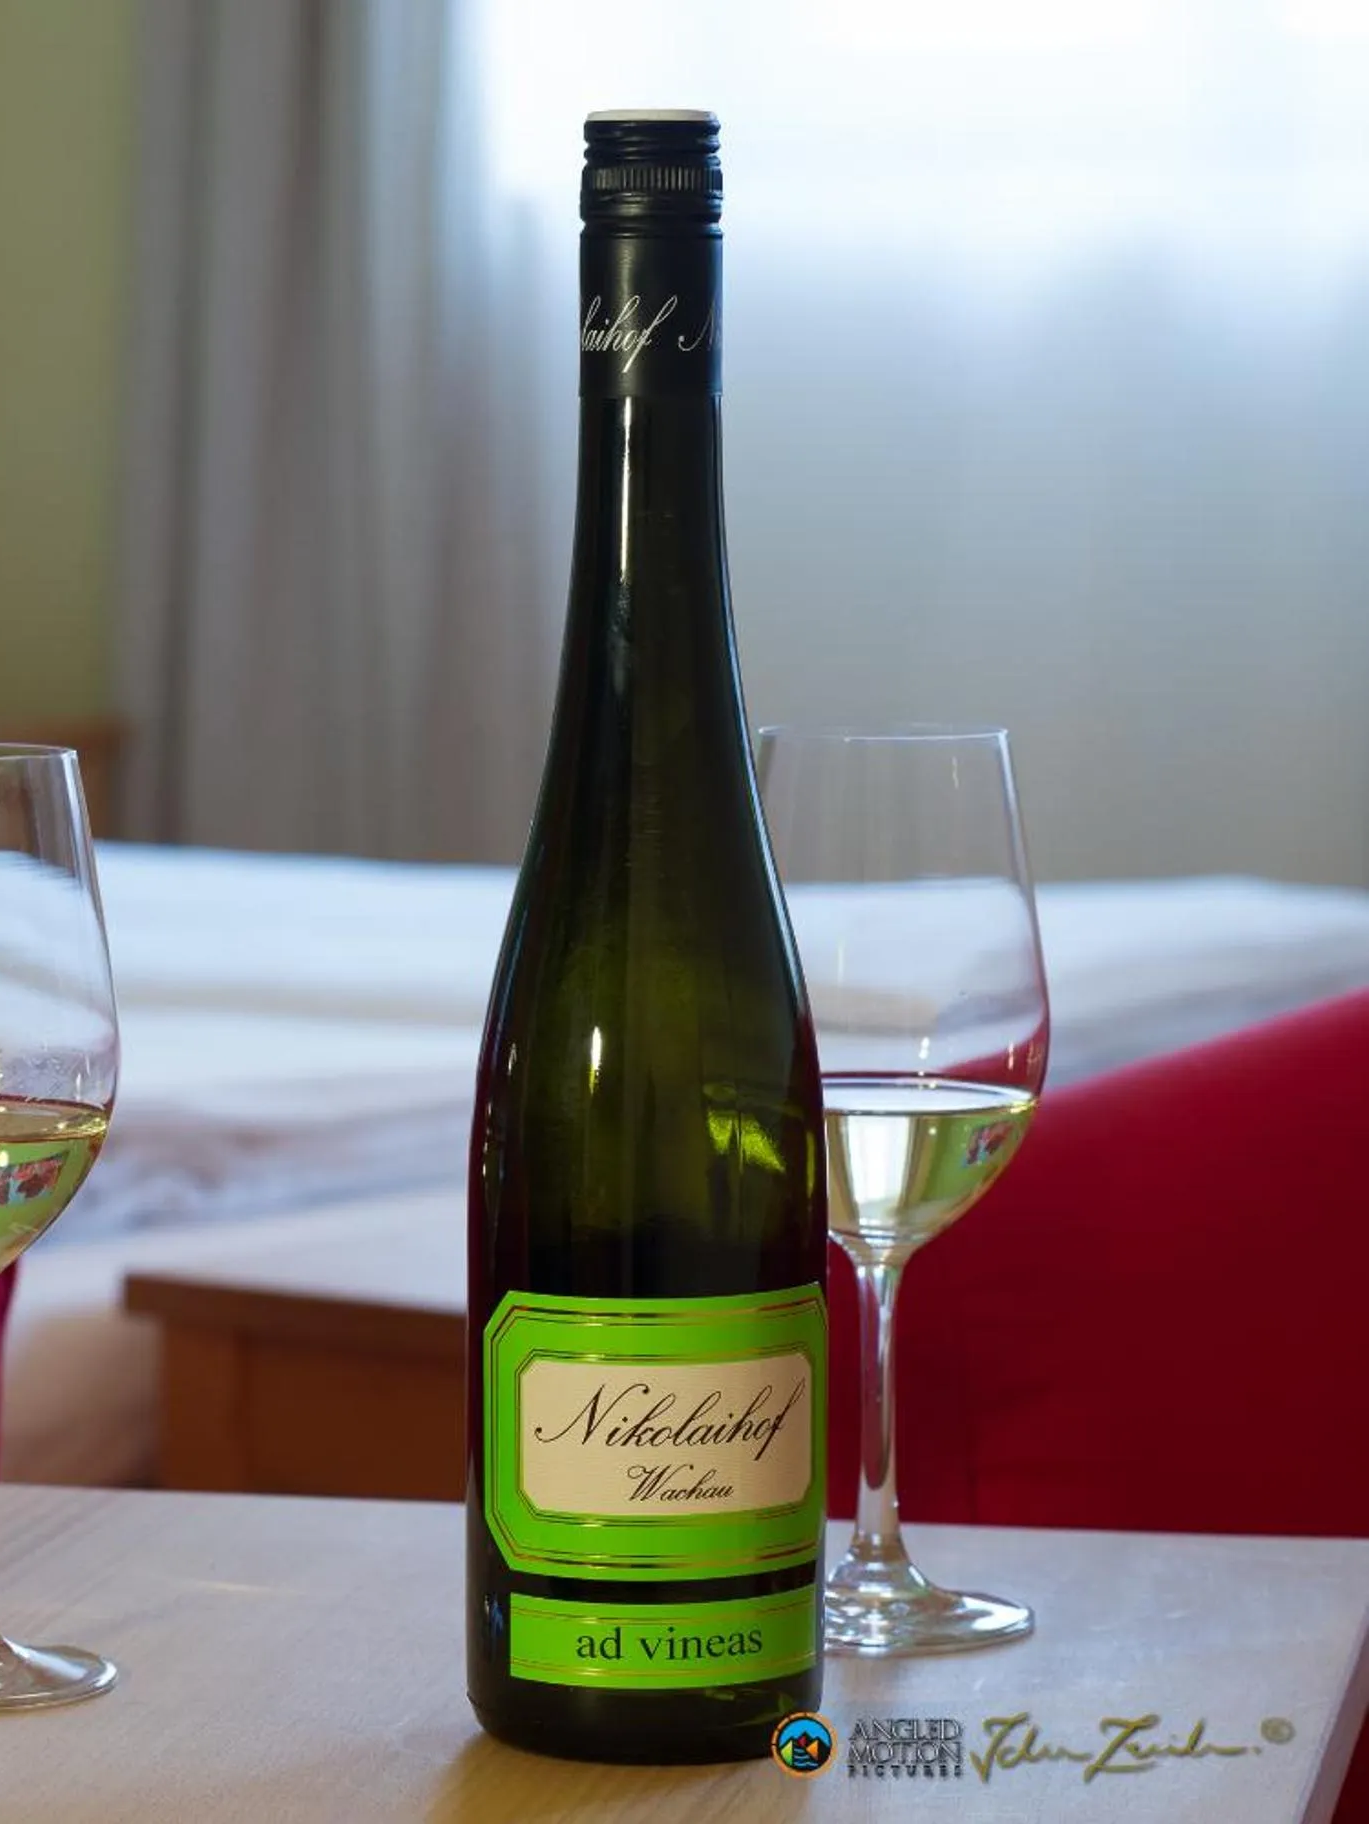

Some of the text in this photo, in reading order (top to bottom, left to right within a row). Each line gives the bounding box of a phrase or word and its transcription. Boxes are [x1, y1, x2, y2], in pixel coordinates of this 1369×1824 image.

[534, 1377, 806, 1461] Nikolaihof
[627, 1463, 735, 1503] Wachau
[575, 1626, 764, 1661] ad vineas
